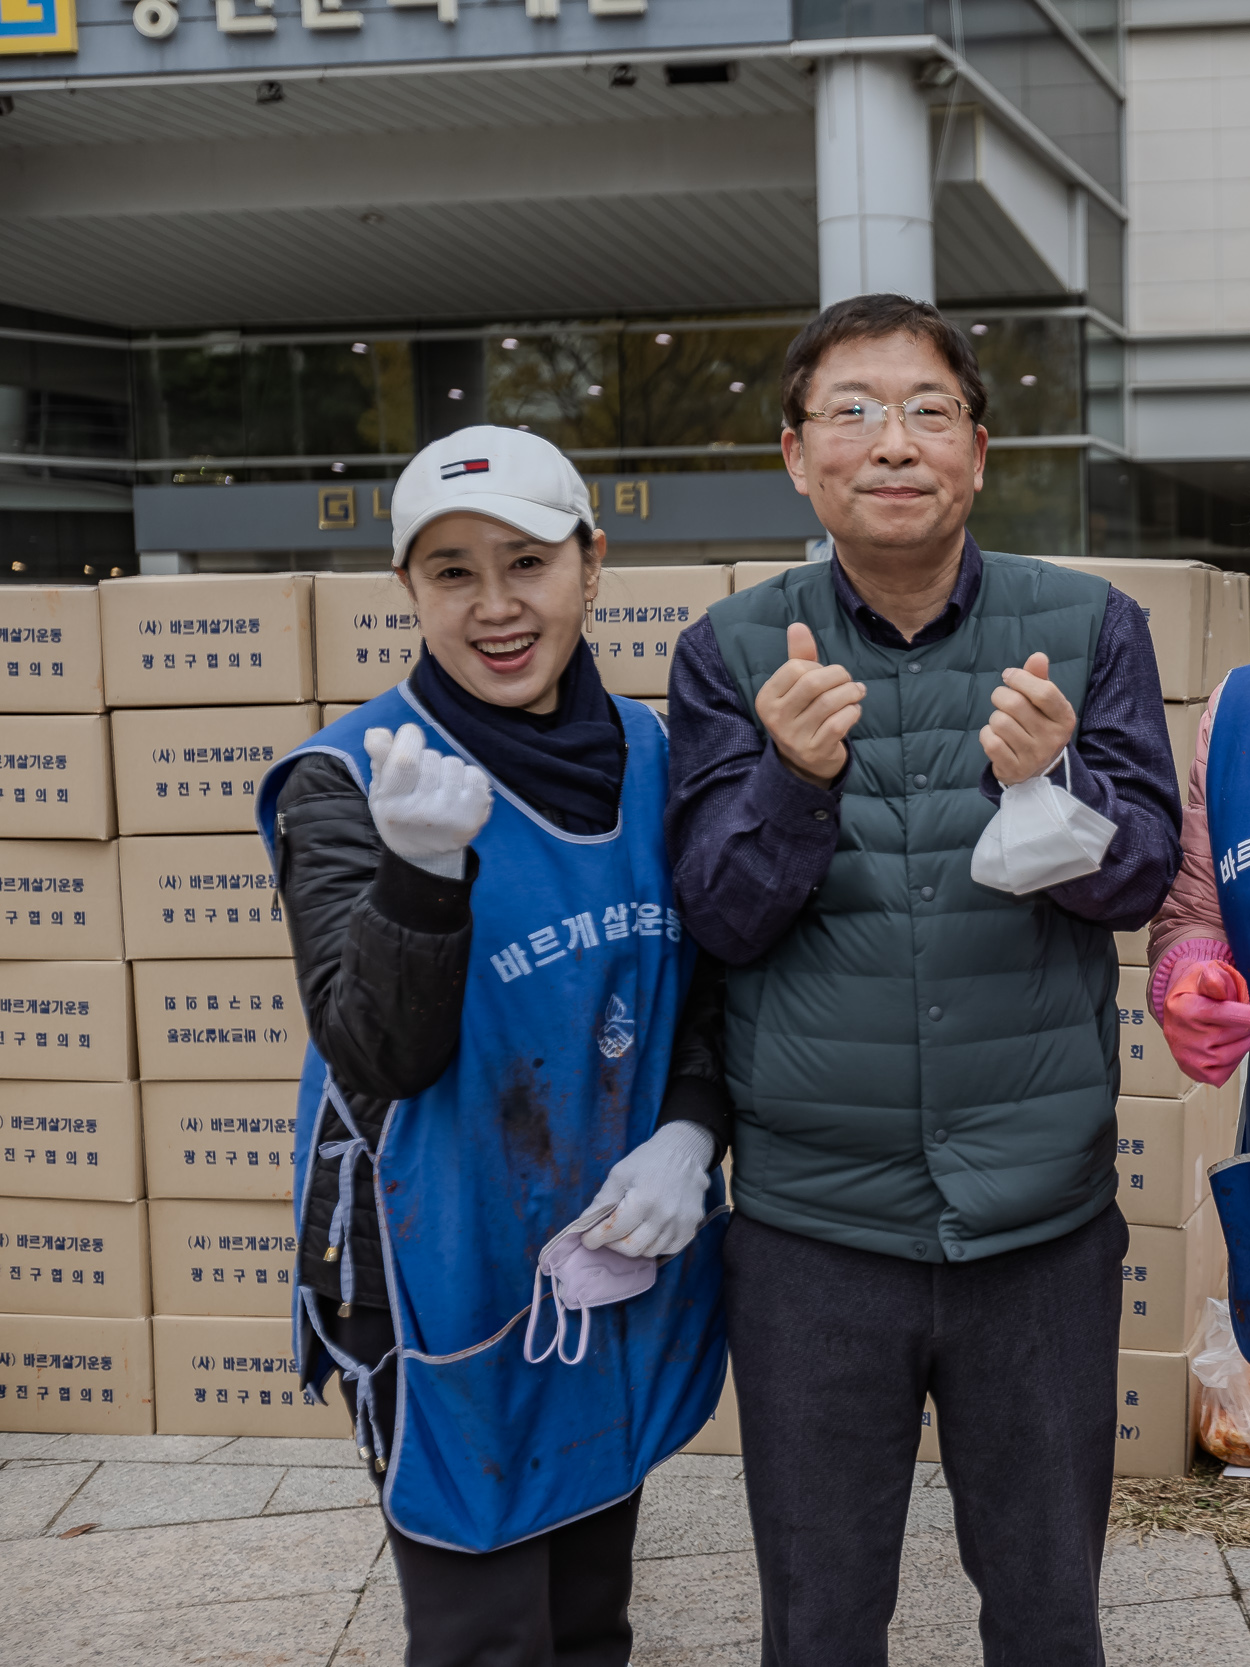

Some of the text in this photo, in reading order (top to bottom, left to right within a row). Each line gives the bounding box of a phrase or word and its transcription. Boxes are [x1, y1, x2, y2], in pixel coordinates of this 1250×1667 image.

[594, 605, 690, 623] 바르게살기운동
[169, 617, 261, 635] 바르게살기운동
[0, 753, 67, 770] 게살기운동
[183, 745, 275, 762] 바르게살기운동
[167, 1027, 257, 1044] 바르게살기운동
[10, 1115, 97, 1134] 바르게살기운동
[16, 1233, 104, 1252] 바르게살기운동
[218, 1234, 299, 1252] 바르게살기운
[23, 1352, 113, 1371] 바르게살기운동
